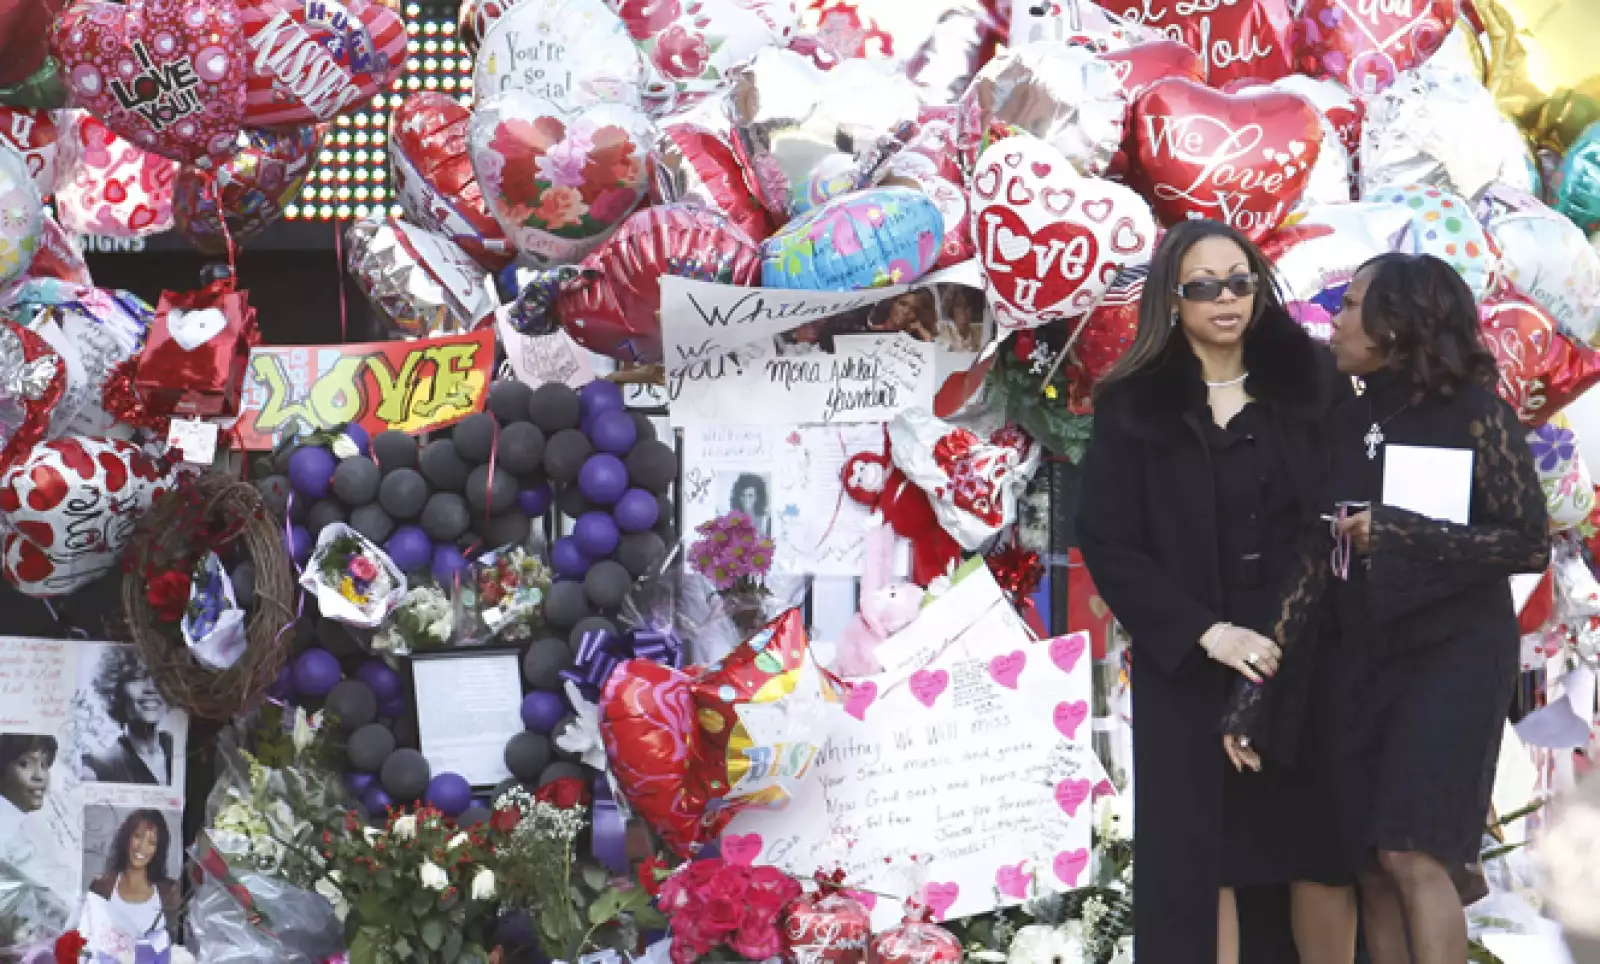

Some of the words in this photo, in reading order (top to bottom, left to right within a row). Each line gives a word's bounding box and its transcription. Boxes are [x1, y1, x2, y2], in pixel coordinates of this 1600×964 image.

[132, 39, 152, 69] I
[249, 8, 360, 122] KISSES
[505, 31, 566, 71] You're
[107, 56, 201, 111] LOVE
[524, 67, 545, 84] so
[1144, 115, 1204, 160] We
[1154, 114, 1283, 206] Love
[1212, 190, 1283, 230] You!
[252, 342, 481, 432] LOVE
